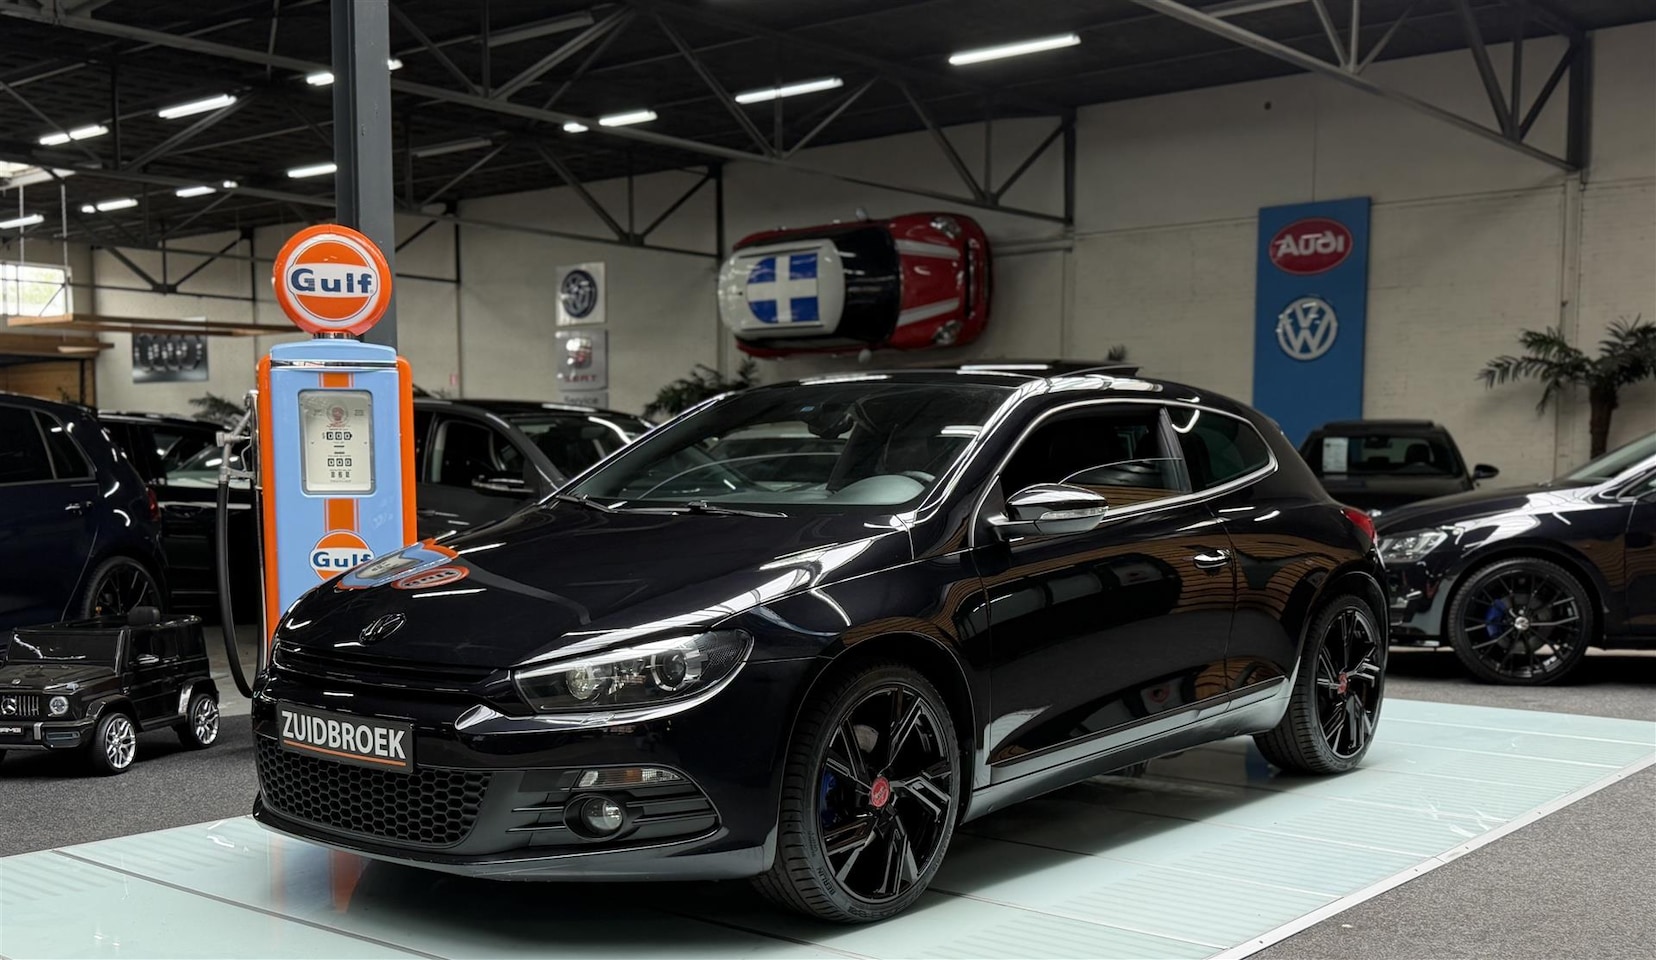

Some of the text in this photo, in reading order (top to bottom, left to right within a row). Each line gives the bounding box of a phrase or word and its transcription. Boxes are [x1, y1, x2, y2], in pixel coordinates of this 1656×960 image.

[290, 268, 373, 294] Gulf
[312, 551, 374, 569] Gulf
[281, 709, 407, 760] ZUIDBROEK
